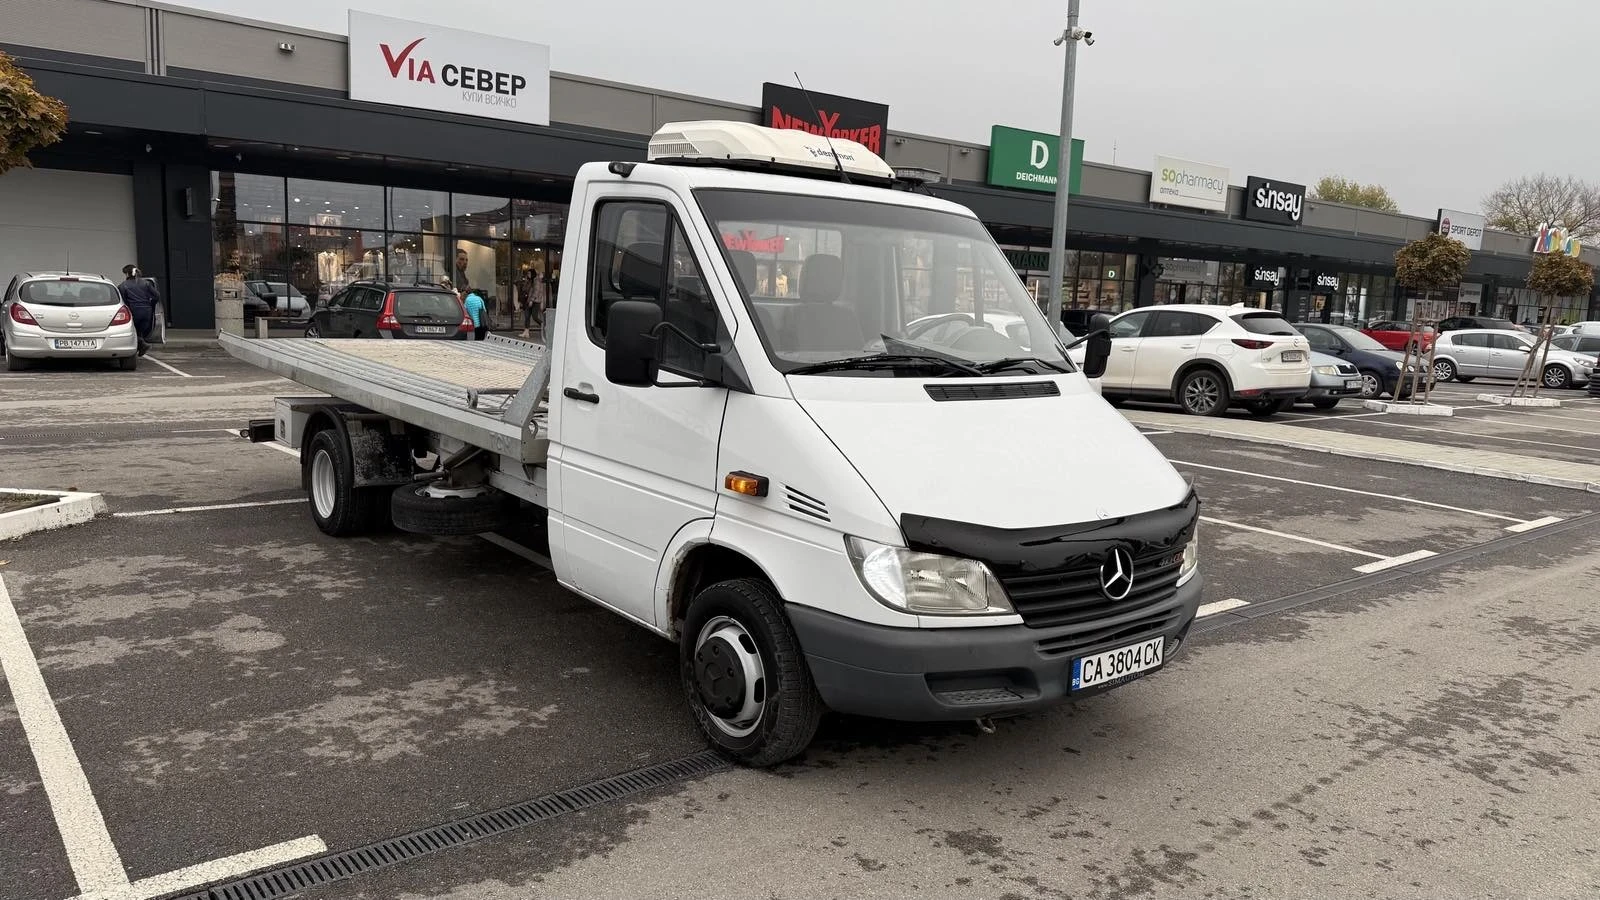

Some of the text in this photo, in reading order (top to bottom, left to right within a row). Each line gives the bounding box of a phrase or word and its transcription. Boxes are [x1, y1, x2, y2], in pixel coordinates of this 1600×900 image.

[379, 37, 526, 96] VIA СЕВЕР
[462, 91, 517, 109] КУПИ ВСИЧКО
[1030, 140, 1049, 169] D
[1256, 183, 1302, 220] sinsay
[1451, 225, 1467, 235] SPORT
[1467, 227, 1482, 237] DEPOT
[1108, 270, 1115, 278] D
[1254, 266, 1280, 286] sinsay
[1316, 272, 1340, 290] sinsay
[1083, 639, 1162, 683] CA 3804 CK
[1072, 677, 1080, 686] BG
